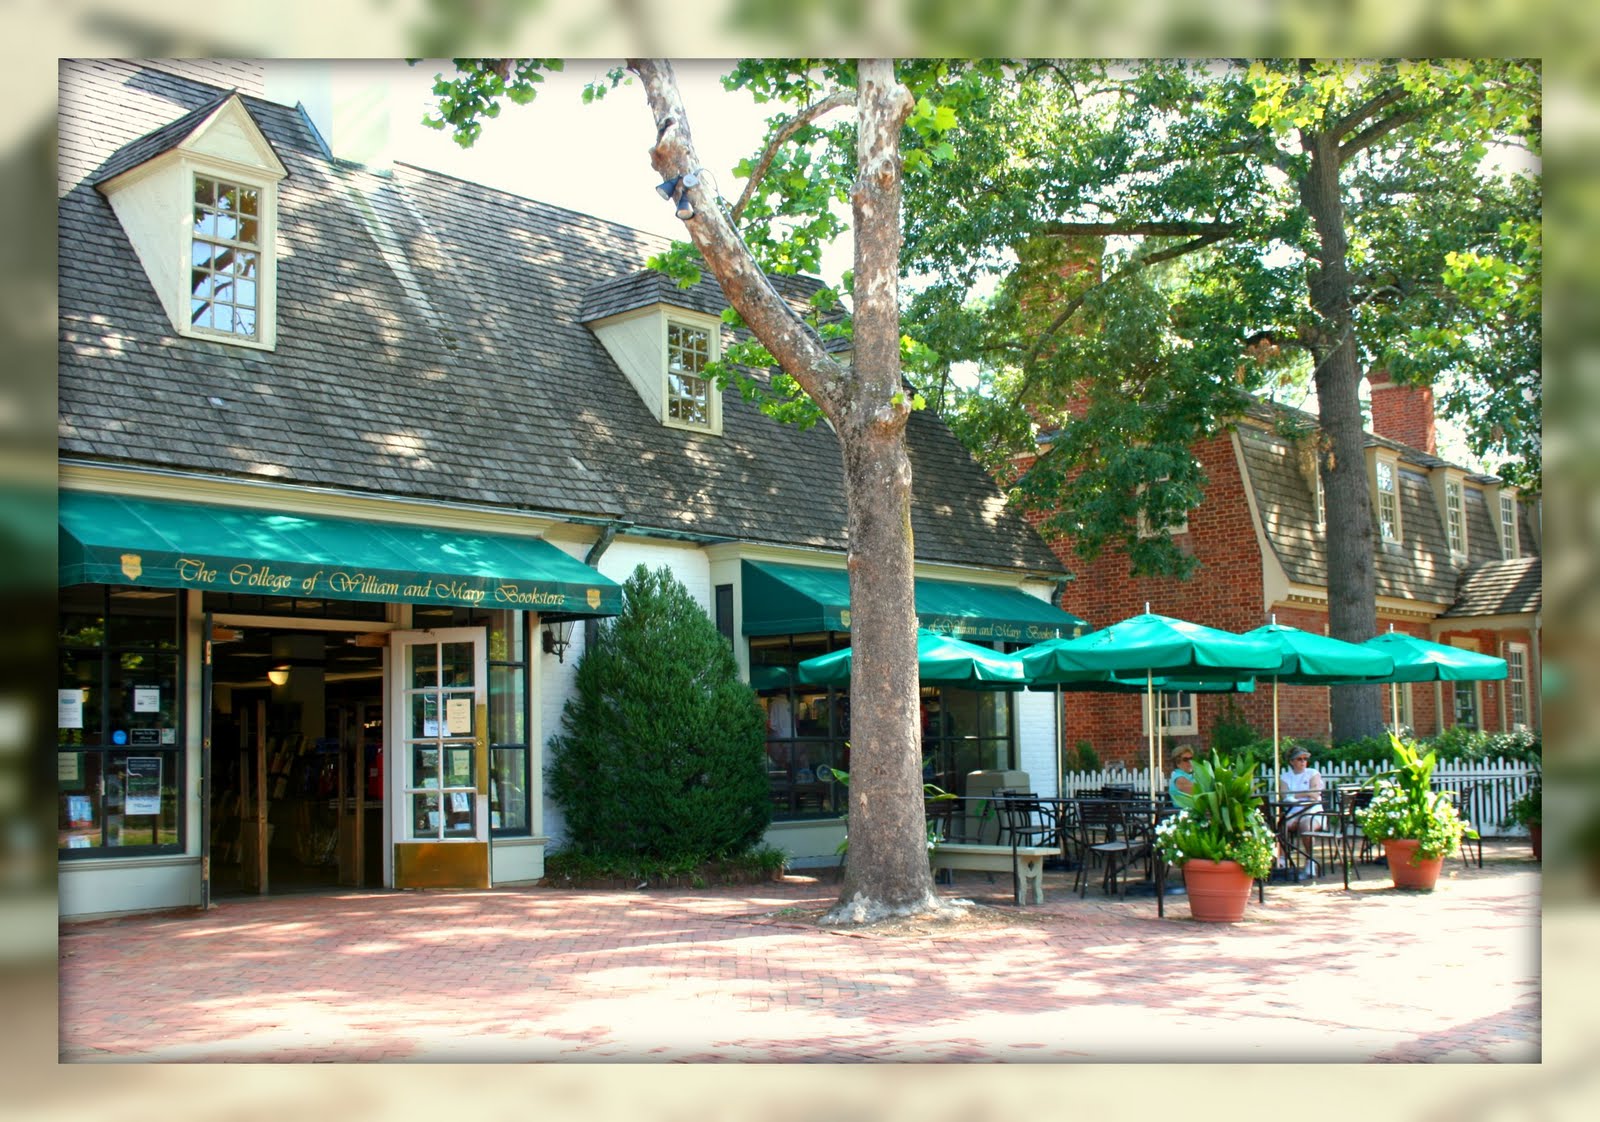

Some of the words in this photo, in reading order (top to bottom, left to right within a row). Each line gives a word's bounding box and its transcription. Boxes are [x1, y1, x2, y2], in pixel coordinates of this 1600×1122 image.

[175, 558, 217, 583] The
[229, 563, 292, 592] College
[302, 570, 323, 595] of
[329, 571, 398, 597] William
[403, 579, 432, 598] and
[435, 581, 485, 607] Mary
[494, 584, 565, 605] Bookstore
[979, 623, 994, 636] and
[995, 624, 1021, 639] Mary
